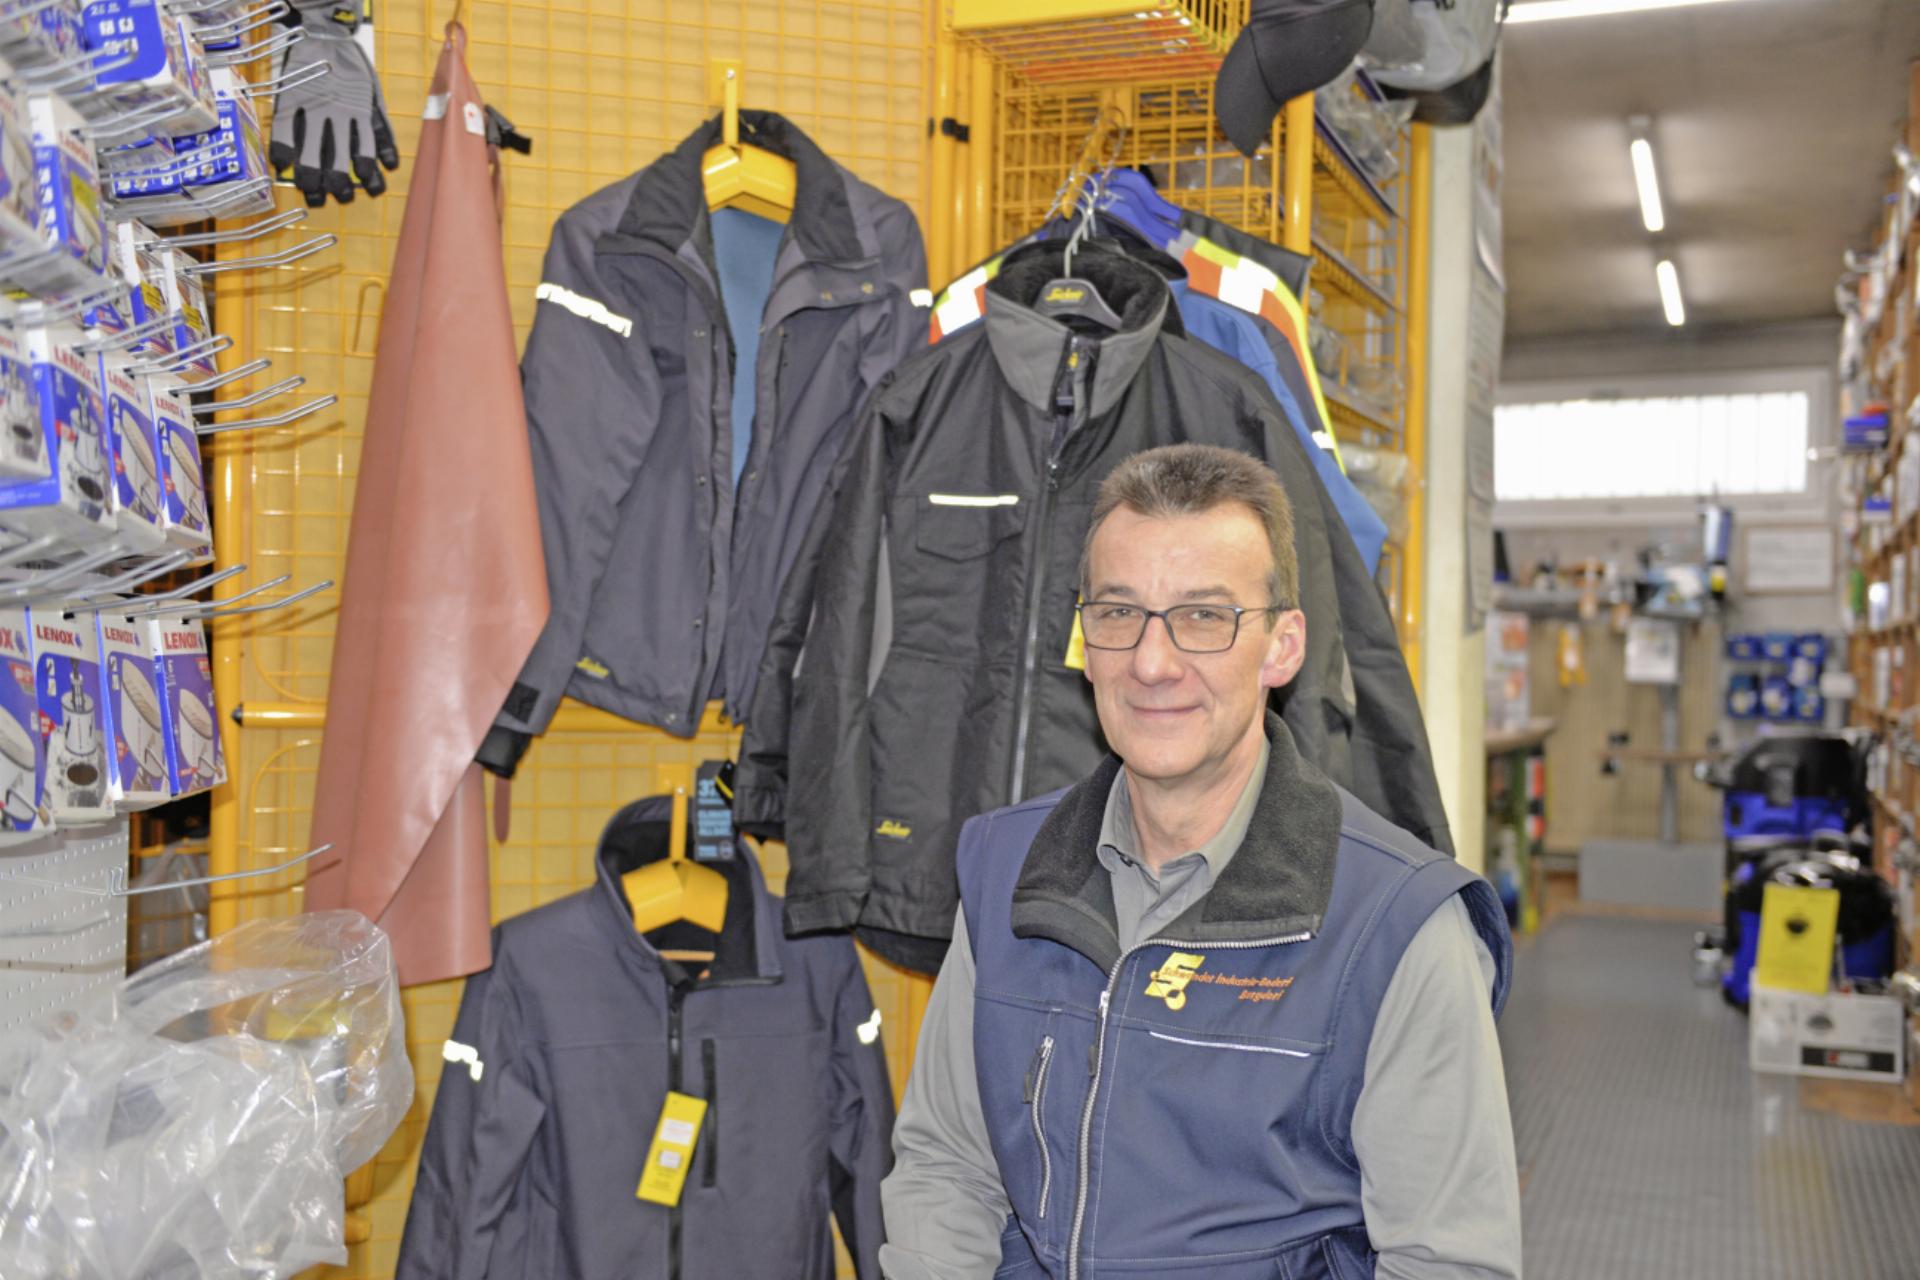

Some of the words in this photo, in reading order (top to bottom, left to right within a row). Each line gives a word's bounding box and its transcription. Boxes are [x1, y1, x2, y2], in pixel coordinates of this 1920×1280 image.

[36, 624, 74, 646] LENOX
[105, 625, 133, 645] LENOX
[163, 632, 198, 650] LENOX
